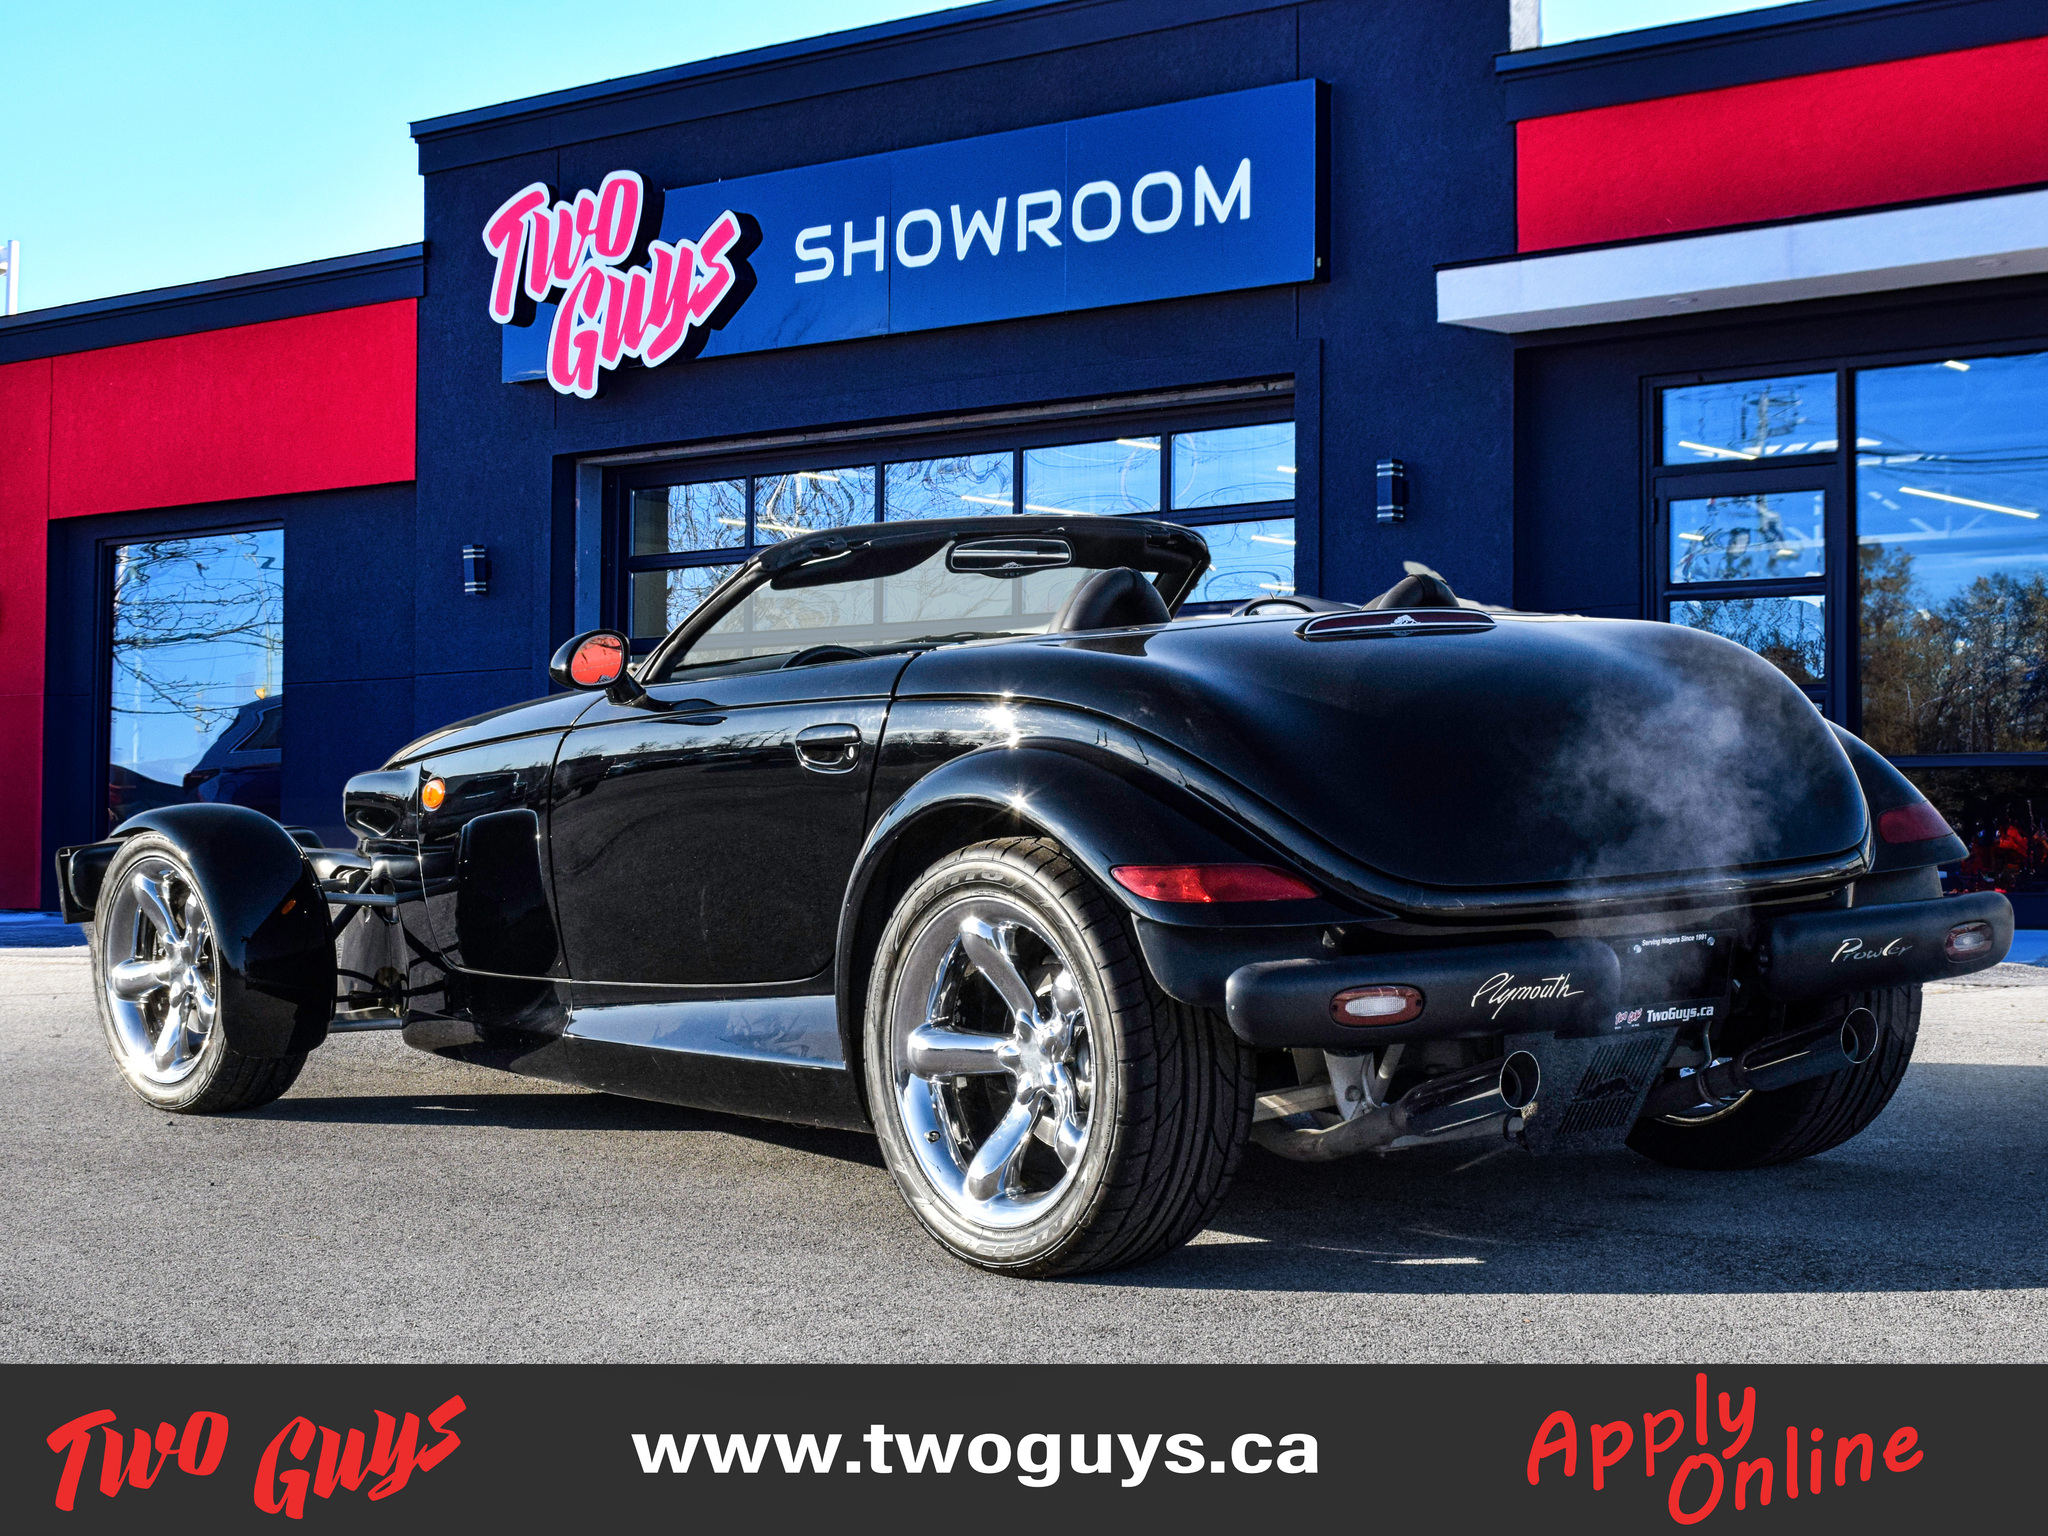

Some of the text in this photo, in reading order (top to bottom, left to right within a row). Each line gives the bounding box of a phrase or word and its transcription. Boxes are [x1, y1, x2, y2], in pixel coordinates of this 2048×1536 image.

[485, 171, 642, 321] Two
[795, 158, 1251, 284] SHOWROOM
[549, 212, 739, 396] Guys
[1831, 937, 1913, 963] Prowler
[1471, 972, 1584, 1020] Plymouth
[1646, 1005, 1714, 1023] TwoGuys.ca
